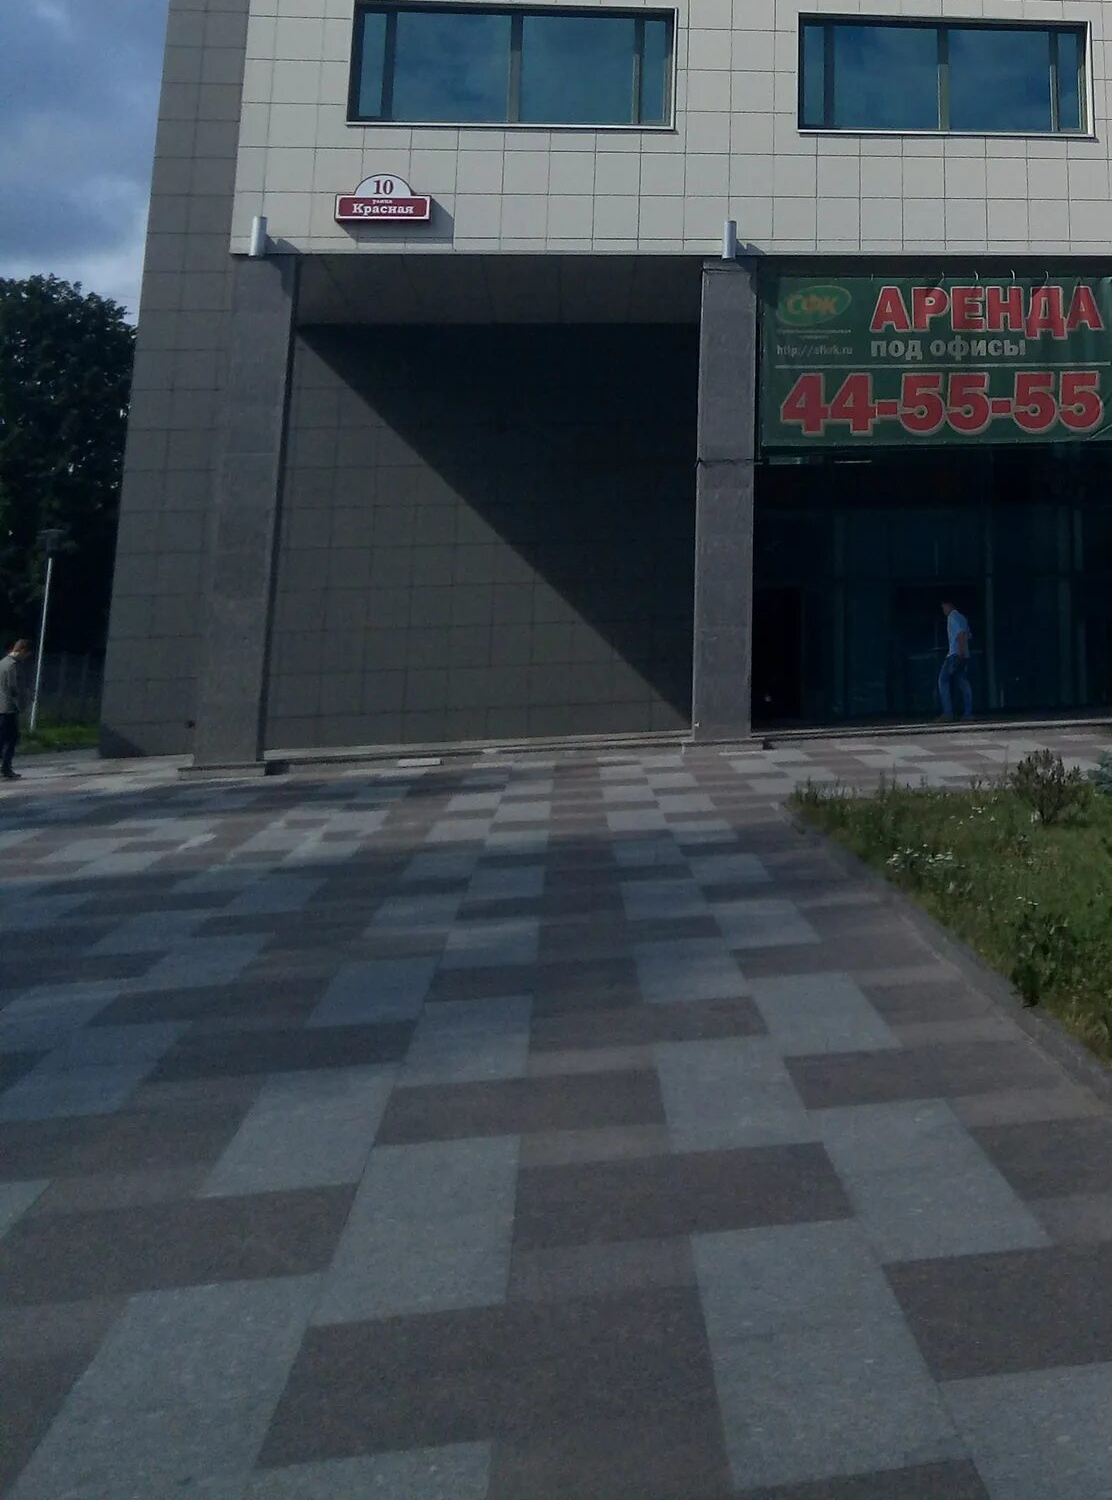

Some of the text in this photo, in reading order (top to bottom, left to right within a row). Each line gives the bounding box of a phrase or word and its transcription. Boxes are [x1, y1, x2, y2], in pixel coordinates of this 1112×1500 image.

[372, 179, 394, 196] 10
[352, 203, 414, 215] Красная
[870, 285, 1106, 340] АРЕНДА
[870, 335, 1027, 361] под офисы
[779, 371, 1105, 437] 44-55-55
